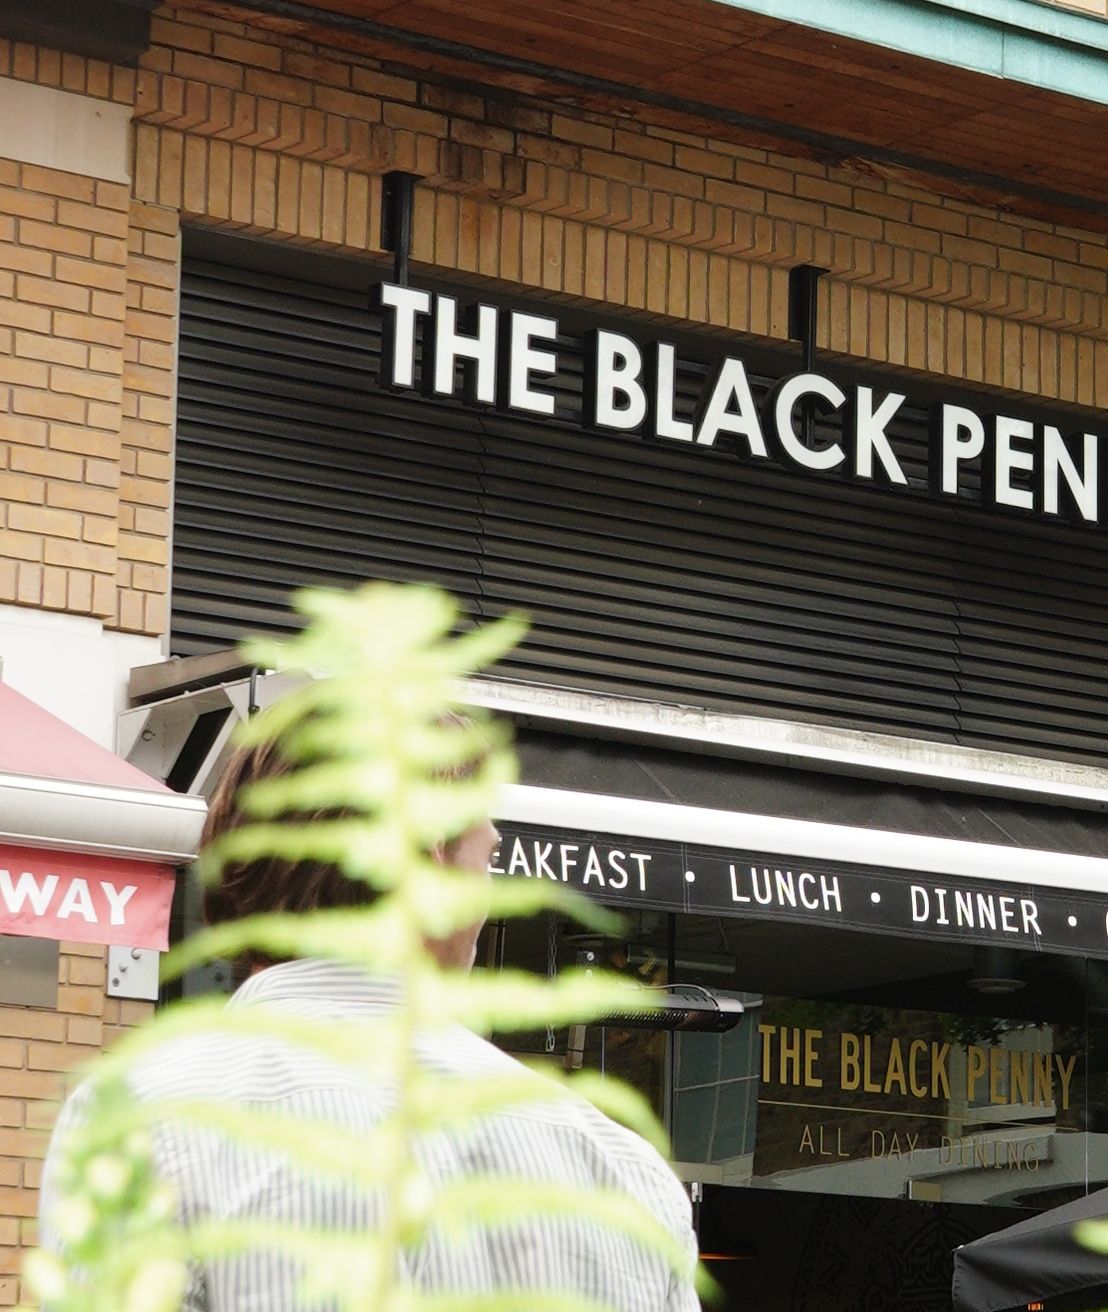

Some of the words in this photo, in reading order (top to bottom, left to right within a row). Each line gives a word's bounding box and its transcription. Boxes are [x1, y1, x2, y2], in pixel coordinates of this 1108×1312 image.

[381, 281, 558, 416] THE
[594, 327, 909, 485] BLACK
[0, 868, 139, 926] WAY
[487, 836, 652, 892] EAKFAST
[729, 864, 842, 913] LUNCH
[910, 885, 1043, 936] DINNER
[757, 1023, 824, 1088] THE
[840, 1032, 951, 1100] BLACK
[967, 1045, 1077, 1110] PENNY
[799, 1123, 850, 1157] ALL
[871, 1129, 920, 1163] DAY
[938, 1135, 1041, 1173] DINING
